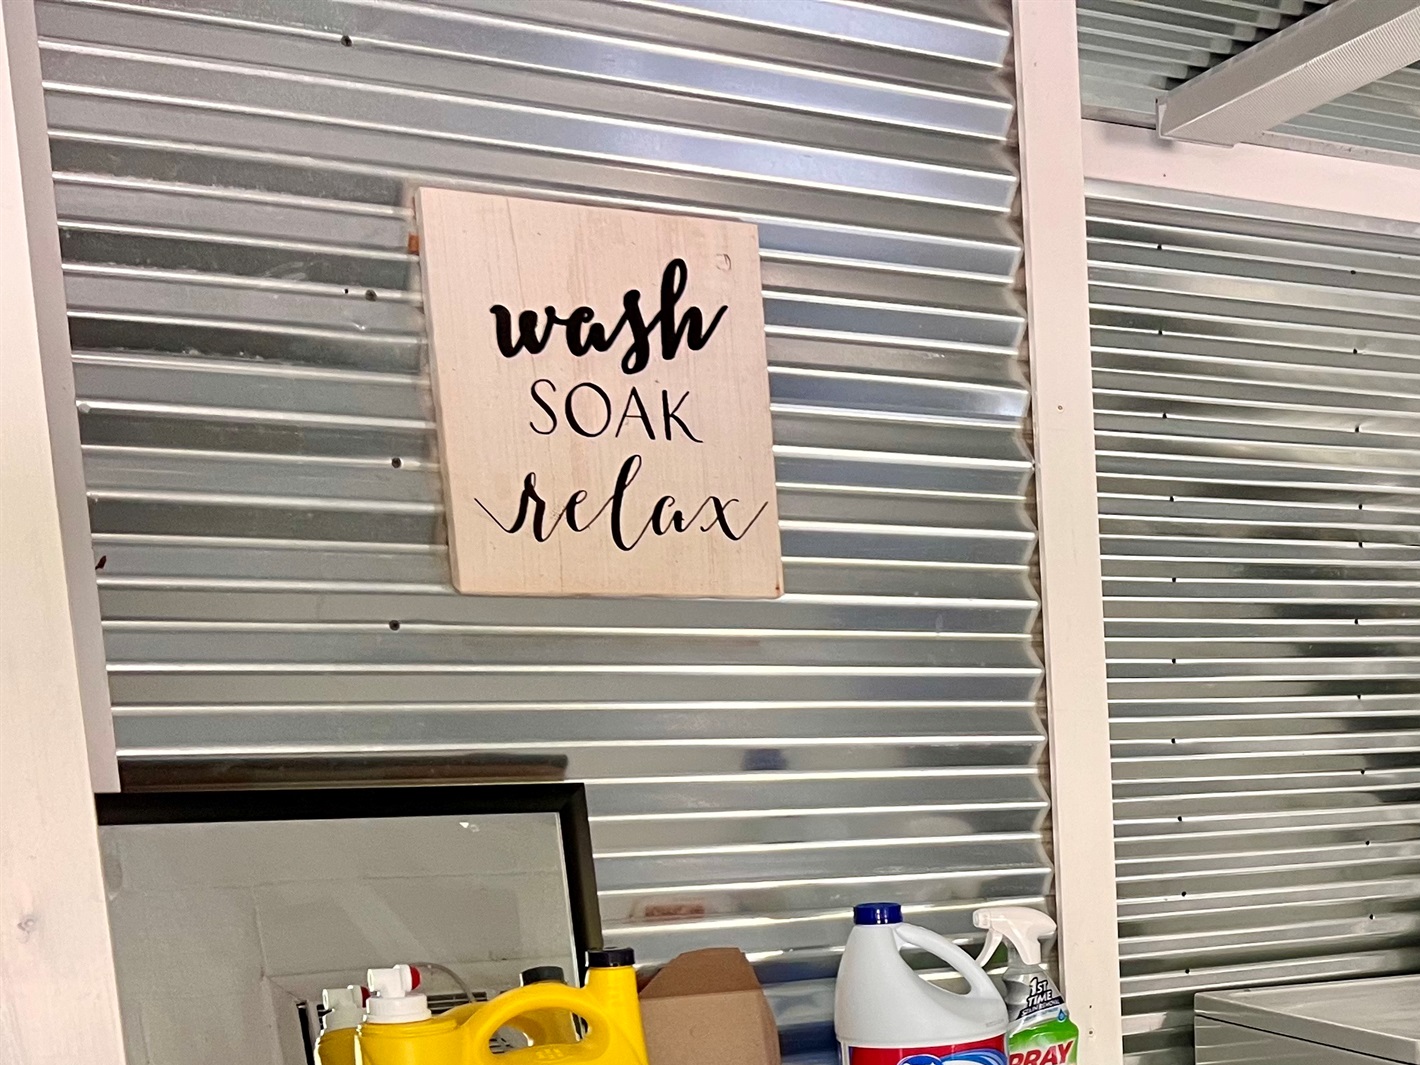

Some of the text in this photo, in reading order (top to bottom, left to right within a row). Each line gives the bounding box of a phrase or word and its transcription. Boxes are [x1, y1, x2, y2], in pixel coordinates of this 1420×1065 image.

[490, 258, 728, 375] wash
[529, 378, 703, 443] SOAK
[474, 454, 769, 551] relax
[1028, 990, 1052, 1007] TIME
